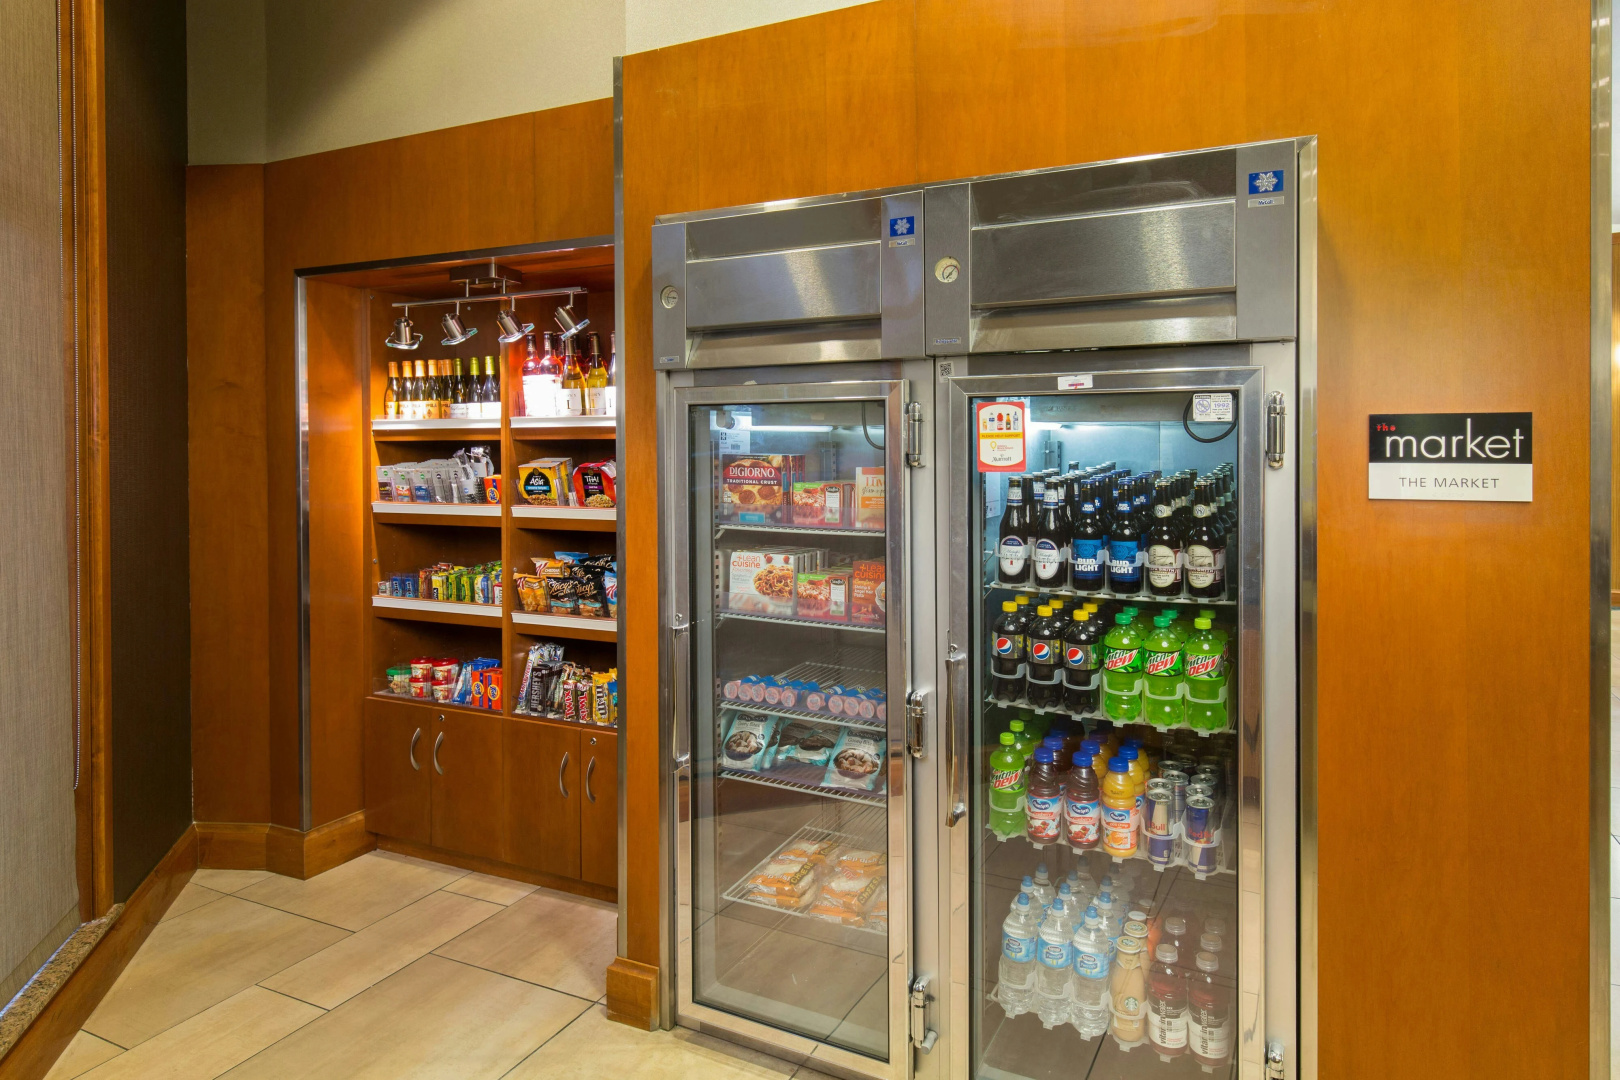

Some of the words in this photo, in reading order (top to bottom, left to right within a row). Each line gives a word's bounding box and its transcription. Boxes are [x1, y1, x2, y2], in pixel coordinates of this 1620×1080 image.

[1376, 423, 1396, 431] the
[1386, 418, 1525, 459] market
[729, 466, 776, 478] DIGIORNO
[1399, 477, 1427, 488] THE
[1434, 477, 1500, 489] MARKET
[1075, 564, 1099, 572] LIGHT
[1112, 559, 1130, 567] BUD
[1110, 566, 1133, 574] LIGHT
[531, 671, 542, 709] HERSHEY'S
[564, 690, 575, 717] Twix
[579, 692, 588, 720] Twix
[1151, 821, 1166, 831] Bull
[790, 861, 814, 884] CHEESE
